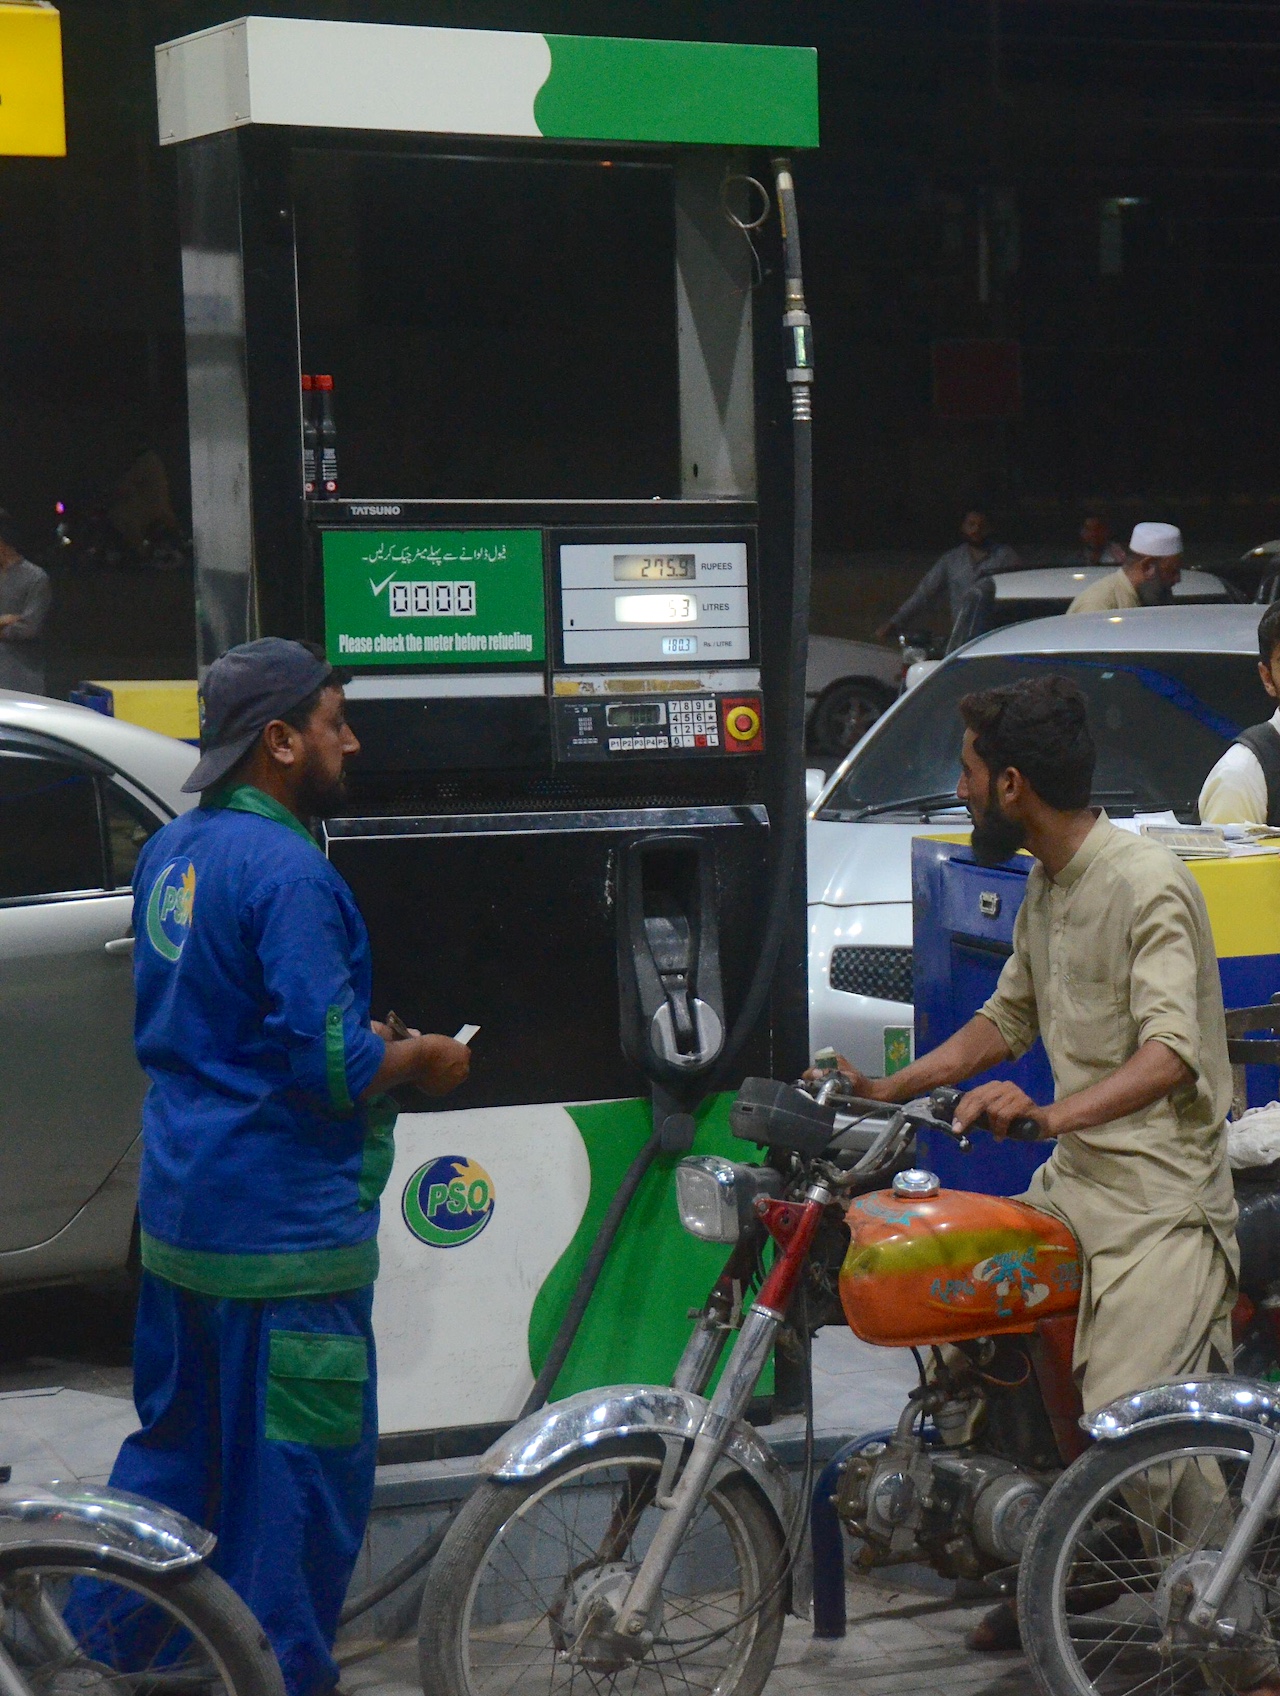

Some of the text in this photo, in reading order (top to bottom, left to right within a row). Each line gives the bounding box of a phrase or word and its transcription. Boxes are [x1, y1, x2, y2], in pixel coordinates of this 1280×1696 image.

[350, 505, 402, 516] TATSUNO
[701, 562, 733, 571] RUPEES
[702, 602, 730, 611] LITRES
[338, 631, 533, 653] Please check the meter before refueling
[634, 739, 643, 747] P3
[646, 739, 655, 747] P4
[658, 738, 668, 746] P5
[427, 1179, 489, 1217] PSO
